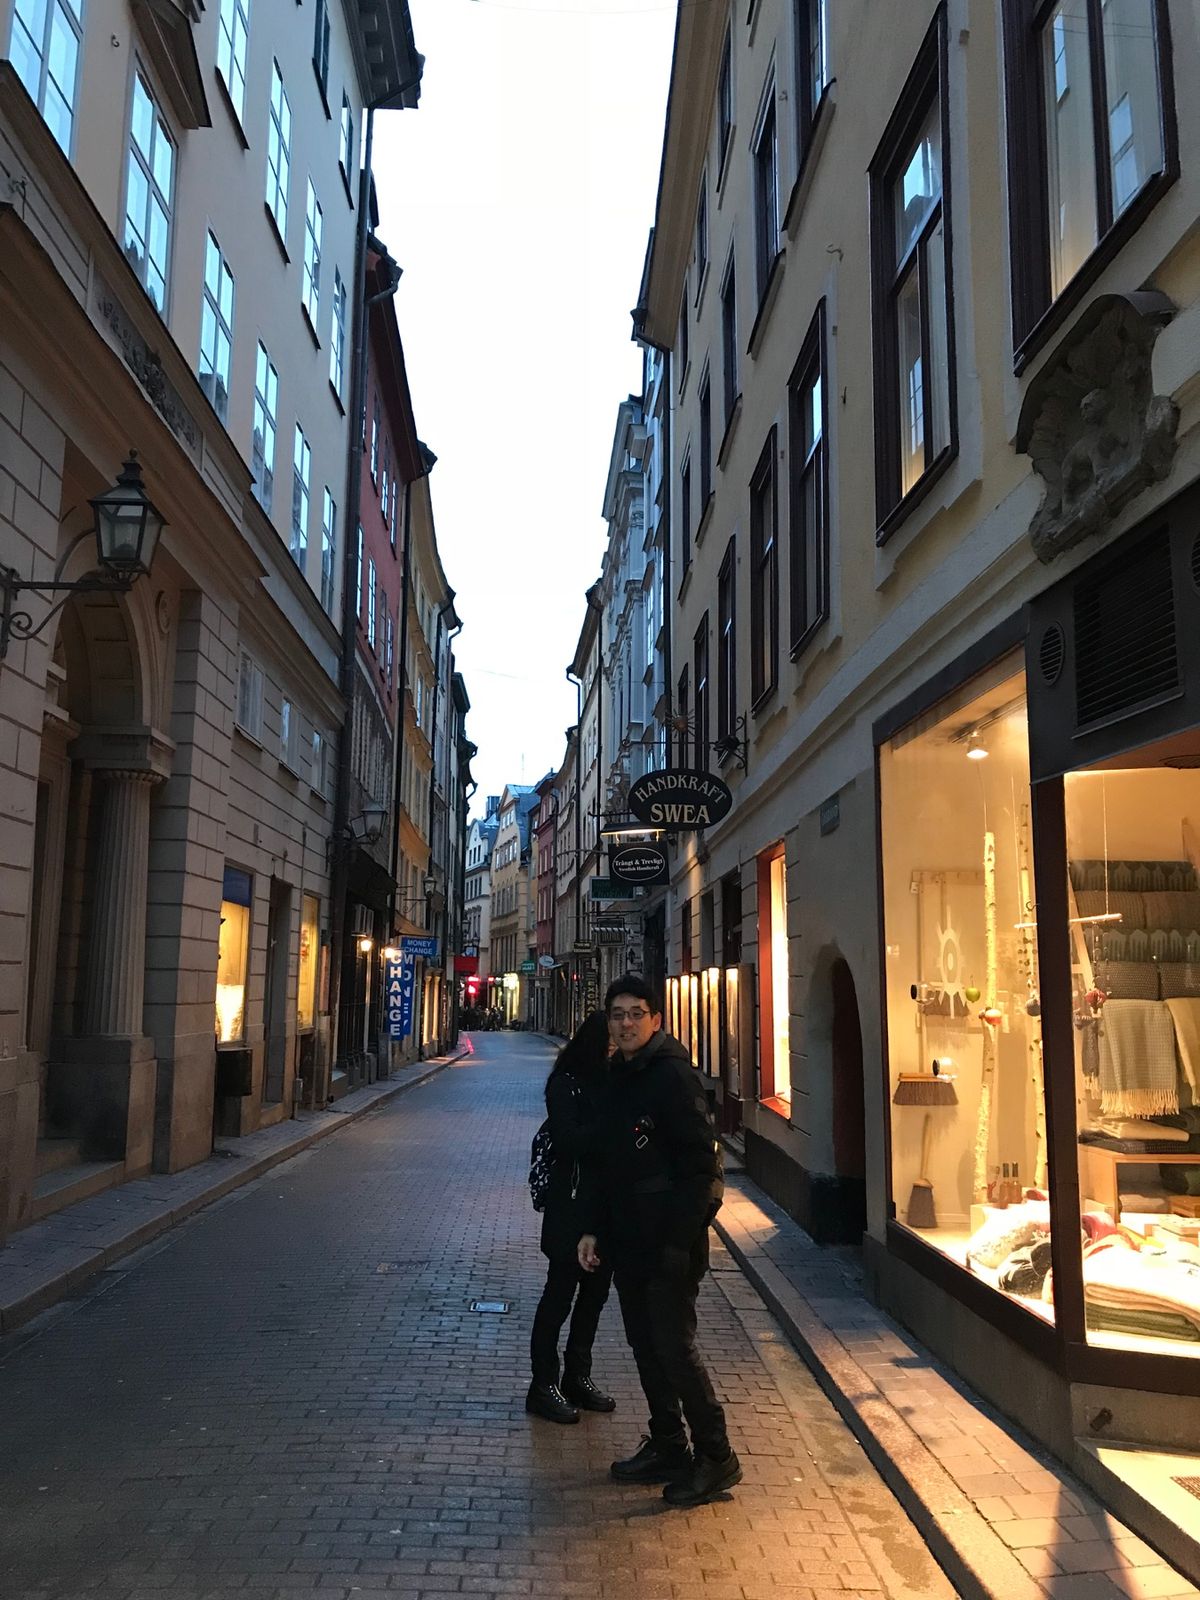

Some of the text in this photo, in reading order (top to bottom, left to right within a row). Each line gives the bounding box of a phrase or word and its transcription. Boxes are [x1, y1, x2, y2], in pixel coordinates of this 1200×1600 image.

[635, 775, 727, 804] HANDKRAFT
[650, 803, 711, 824] SWEA
[390, 950, 402, 1036] CHANGE
